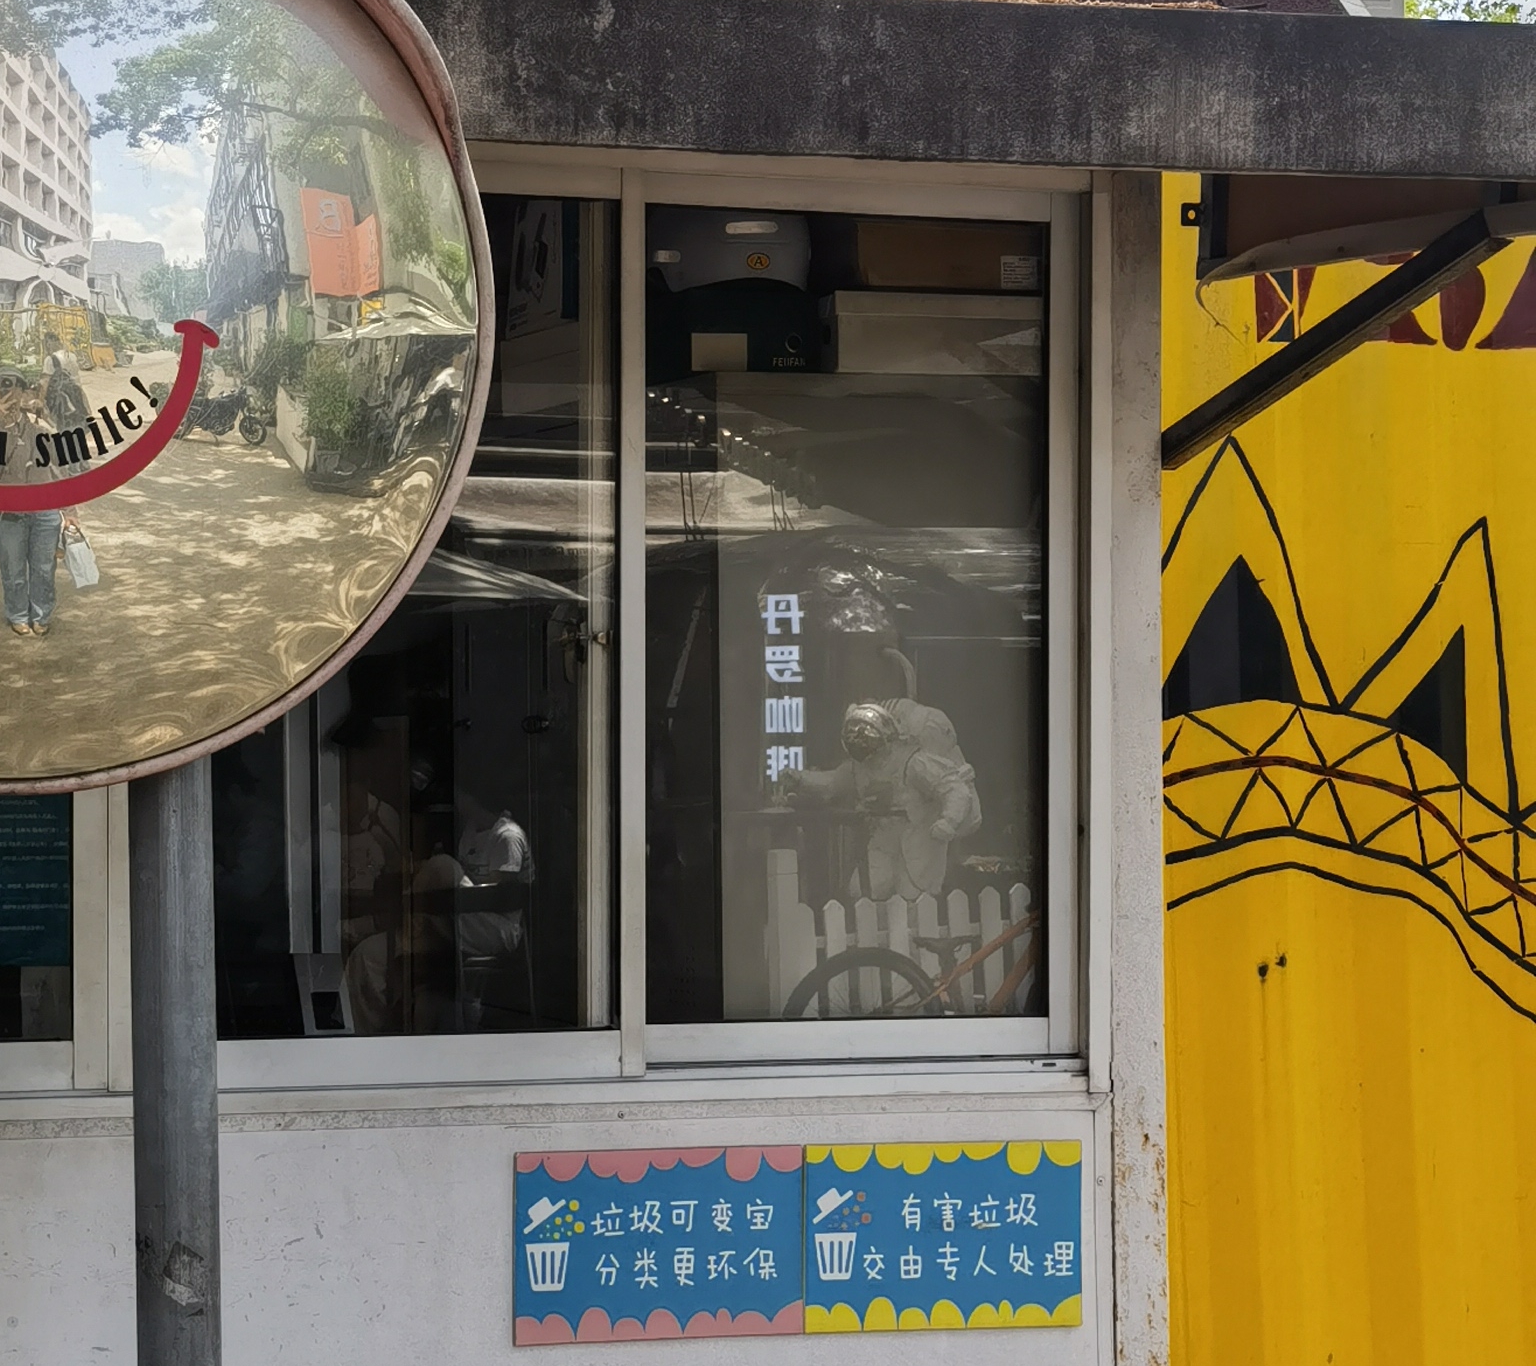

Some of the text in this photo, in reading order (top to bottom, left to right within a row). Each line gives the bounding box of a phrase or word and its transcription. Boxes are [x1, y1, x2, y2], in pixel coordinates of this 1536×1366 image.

[36, 376, 158, 468] smile!
[591, 1198, 774, 1237] 垃圾可变宝
[901, 1192, 1039, 1232] 有害垃圾
[595, 1247, 778, 1290] 分类更环保
[863, 1241, 1075, 1281] 交由专人处理
